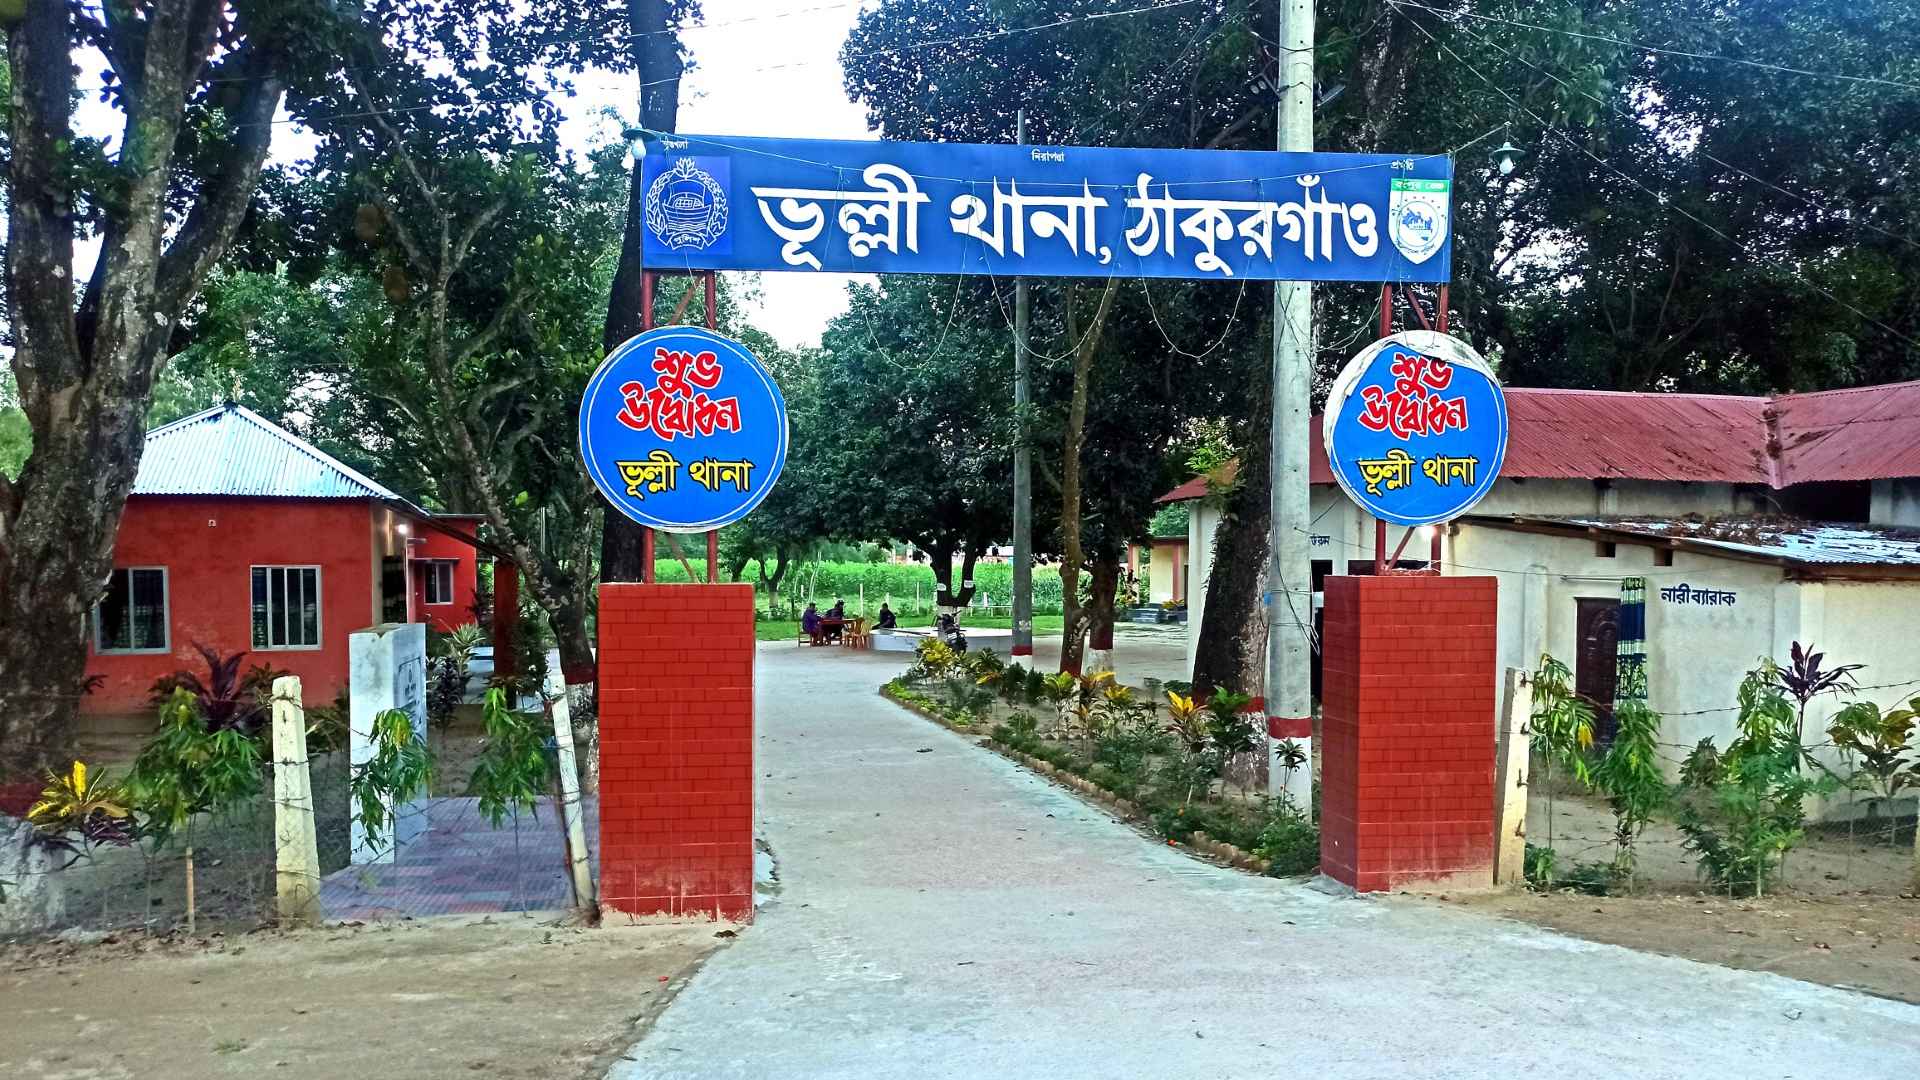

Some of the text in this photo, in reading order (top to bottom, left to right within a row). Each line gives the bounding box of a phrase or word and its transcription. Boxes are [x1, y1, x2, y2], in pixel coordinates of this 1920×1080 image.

[1031, 148, 1065, 162] নিরাপত্তা
[750, 163, 1379, 276] ভূল্লী থানা, ঠাকুরগাঁও
[651, 348, 723, 398] শুভ
[1390, 352, 1453, 398] শুভ
[616, 381, 741, 442] উদ্বোধন
[1357, 384, 1468, 441] উদ্বোধন
[616, 449, 755, 500] ভূল্লী থানা
[1357, 448, 1480, 496] ভূল্লী থানা
